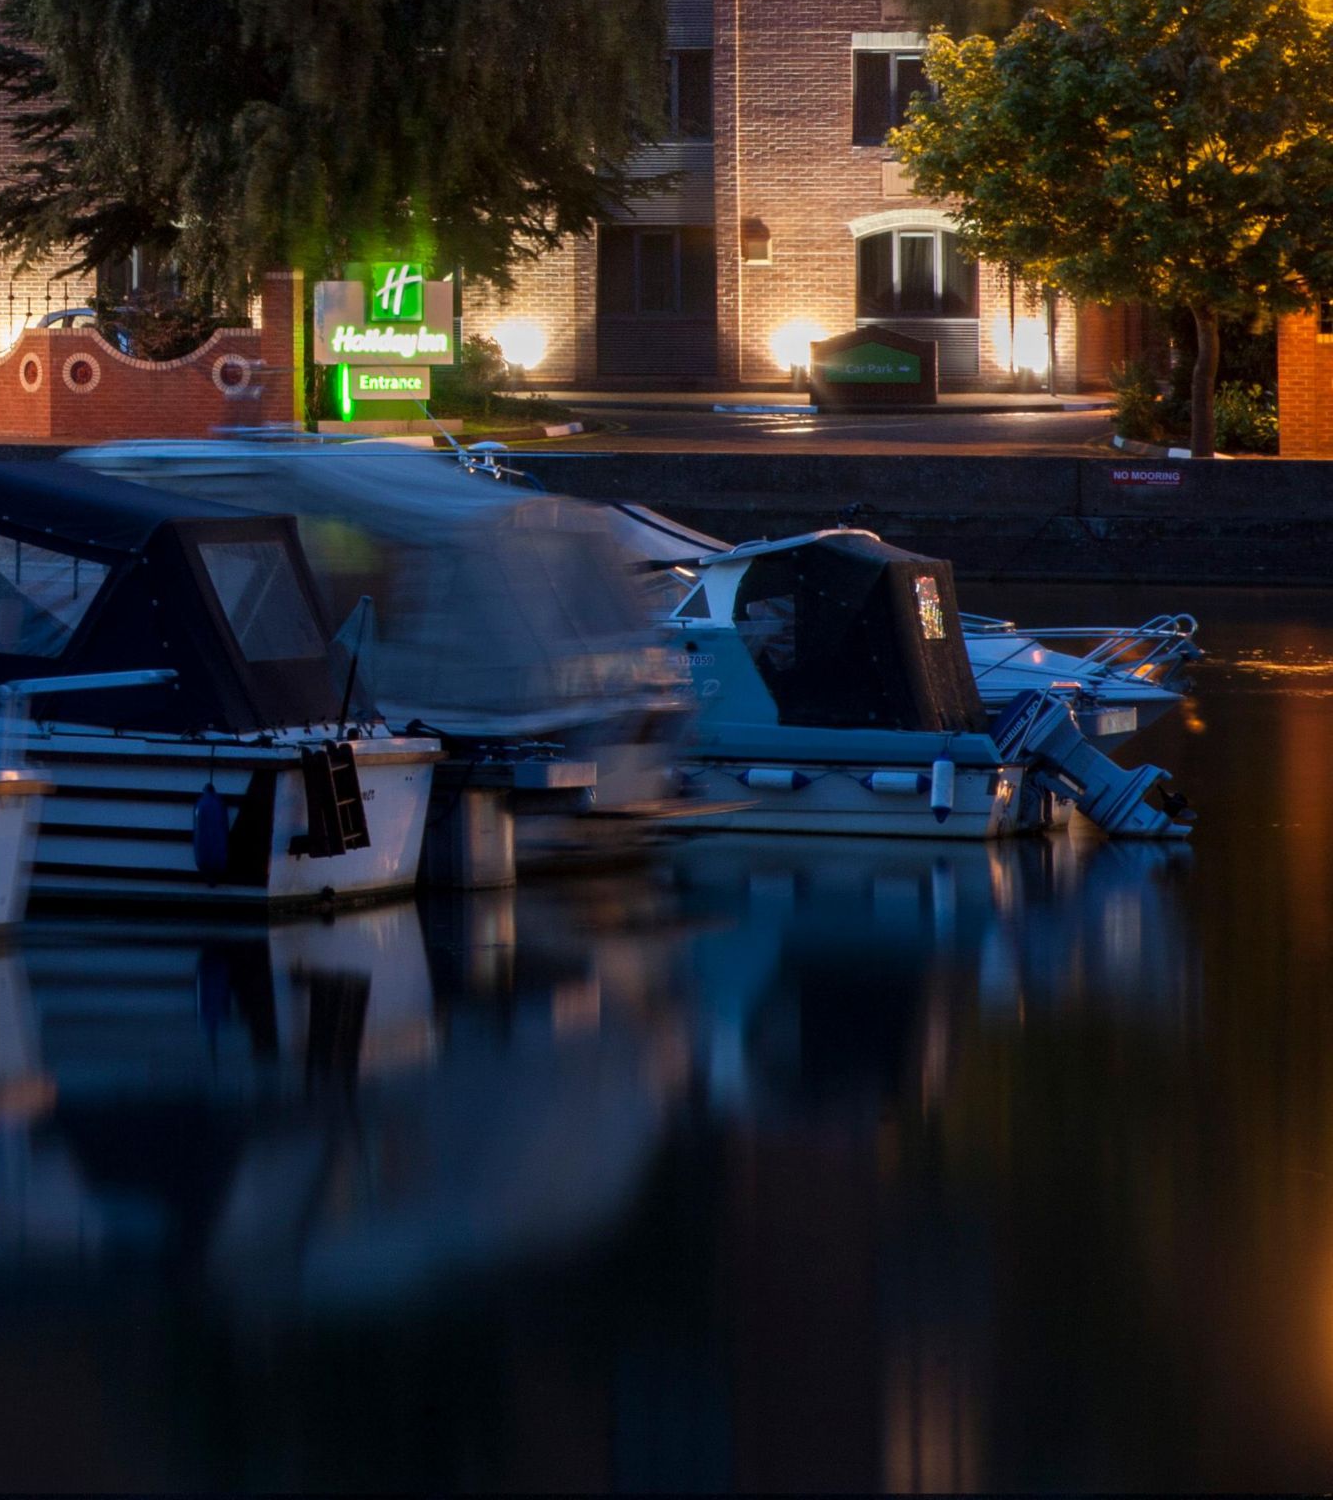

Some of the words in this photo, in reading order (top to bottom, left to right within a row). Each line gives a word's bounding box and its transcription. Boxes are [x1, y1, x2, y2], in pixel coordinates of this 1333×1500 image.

[332, 325, 418, 359] Holiday
[417, 325, 448, 353] Inn
[846, 364, 865, 374] Car
[868, 363, 894, 374] Park
[359, 374, 423, 390] Entrance
[1113, 471, 1129, 480] NO
[1131, 471, 1181, 481] MOORING
